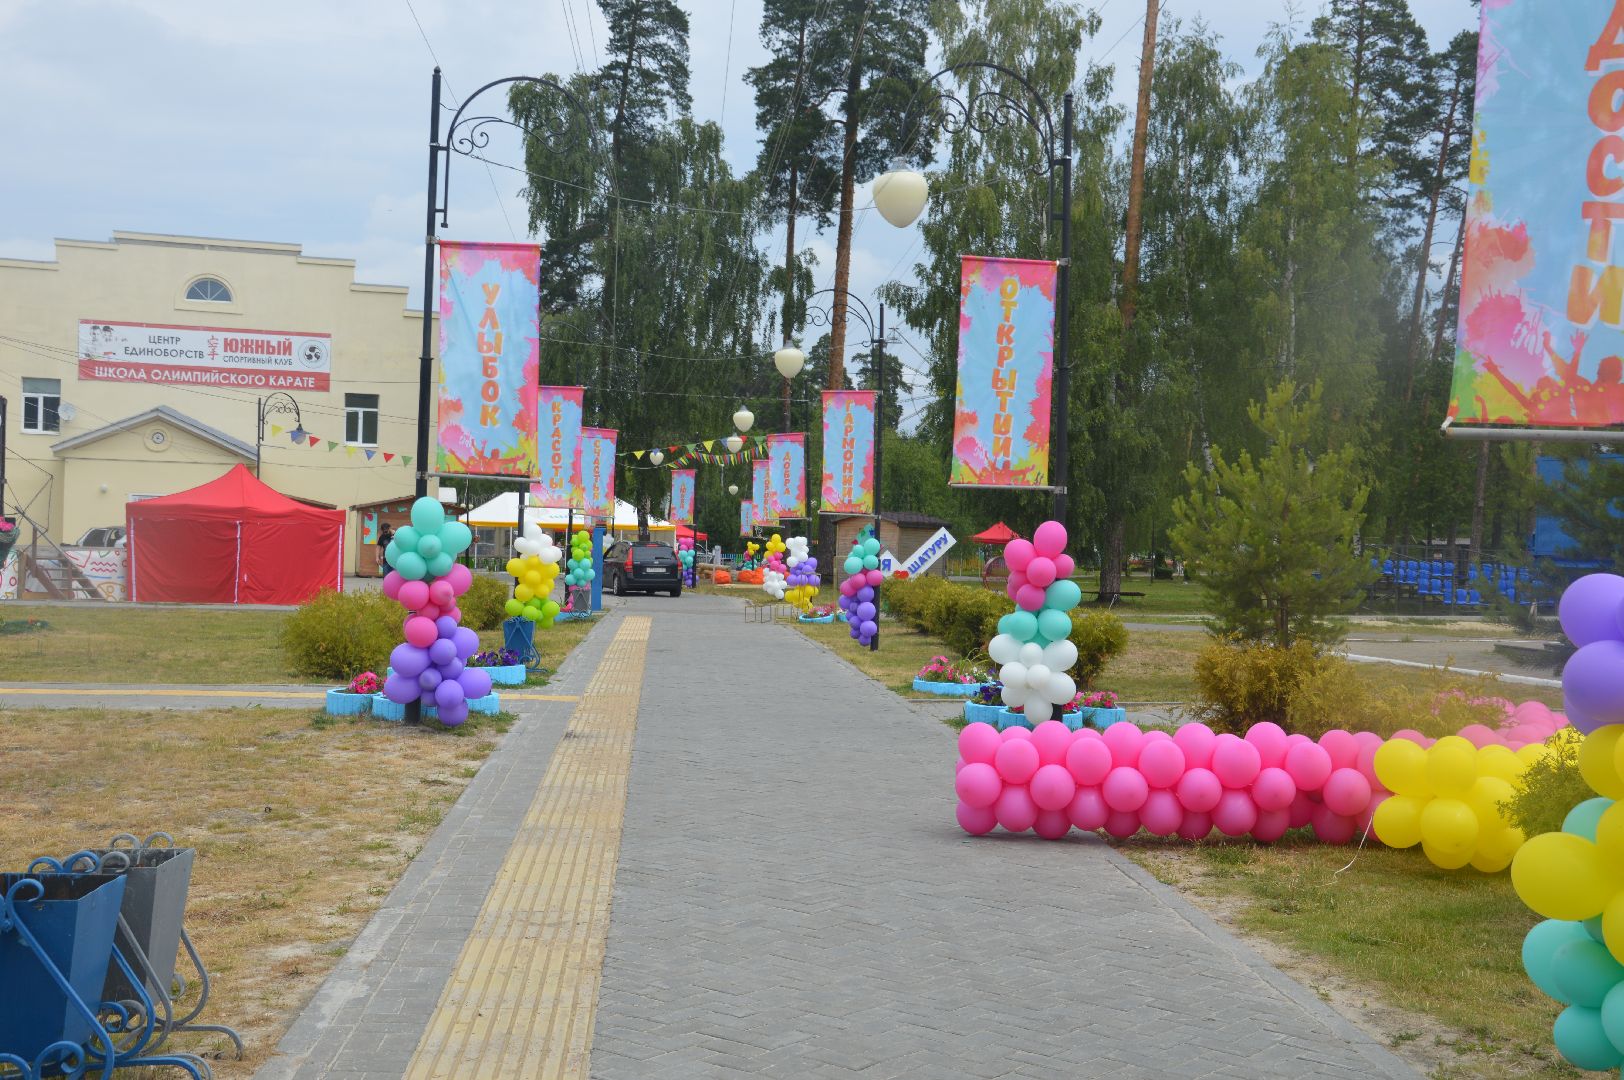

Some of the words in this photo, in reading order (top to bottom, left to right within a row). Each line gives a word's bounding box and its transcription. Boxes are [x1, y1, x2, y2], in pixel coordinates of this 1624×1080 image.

[148, 335, 181, 346] ЦЕНТР
[223, 337, 293, 356] ЮЖНЫЙ
[124, 346, 205, 360] ЕДИНОБОРСТВ
[223, 355, 273, 366] СПОРТИВНЫЙ
[274, 358, 293, 366] КЛУБ
[477, 283, 503, 426] УЛЫБОК
[94, 365, 148, 381] ШКОЛА
[151, 367, 266, 386] ОЛИМПИЙСКОГО
[269, 375, 316, 388] КАРАТЕ
[550, 401, 564, 490] КРАСОТЫ
[842, 399, 856, 498] ГАРМОНИИ
[882, 558, 892, 572] Я
[908, 533, 950, 575] ШАТУРУ
